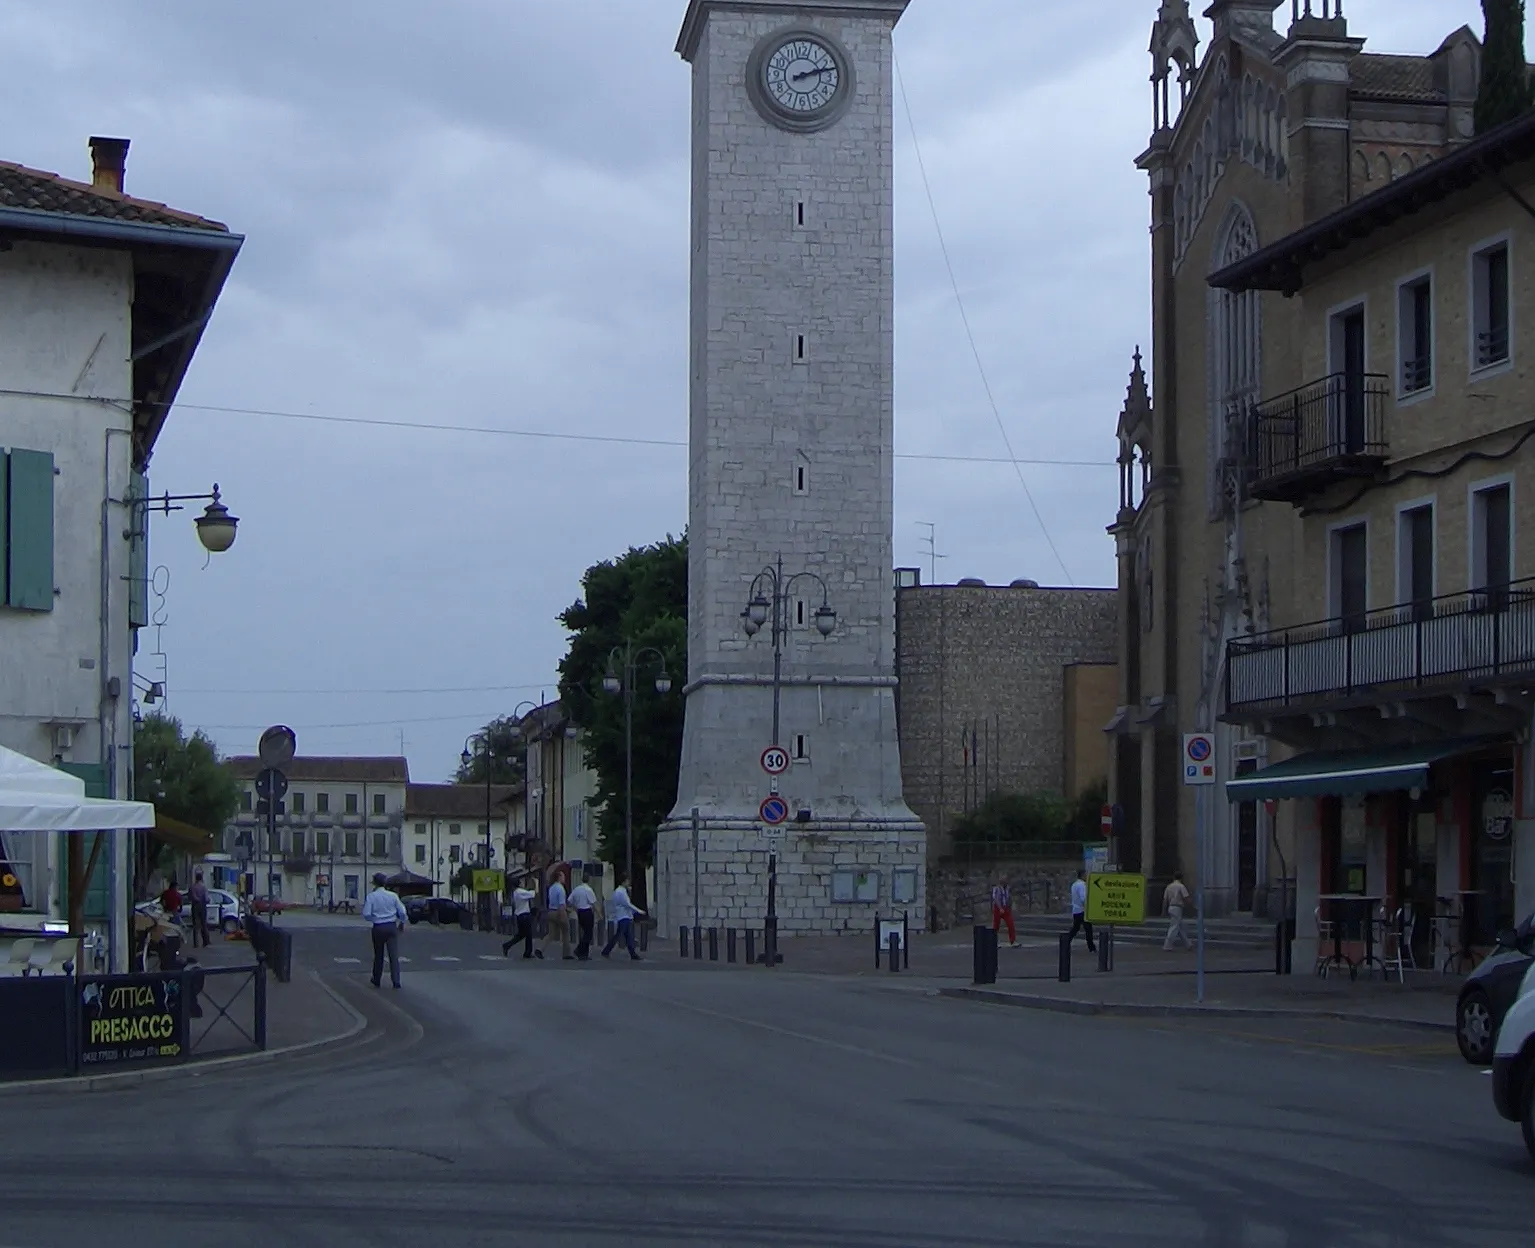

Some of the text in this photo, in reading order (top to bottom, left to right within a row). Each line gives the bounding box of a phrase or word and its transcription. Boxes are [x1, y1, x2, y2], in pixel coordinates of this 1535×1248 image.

[787, 49, 794, 58] 11
[798, 47, 808, 57] 12
[775, 58, 785, 68] 10
[773, 70, 779, 79] 9
[826, 72, 832, 82] 3
[776, 83, 782, 92] 8
[821, 86, 828, 95] 4
[799, 96, 805, 106] 6
[812, 95, 818, 104] 5
[767, 754, 784, 768] 30
[109, 985, 156, 1010] OTTICA
[90, 1013, 174, 1044] PRESACCO
